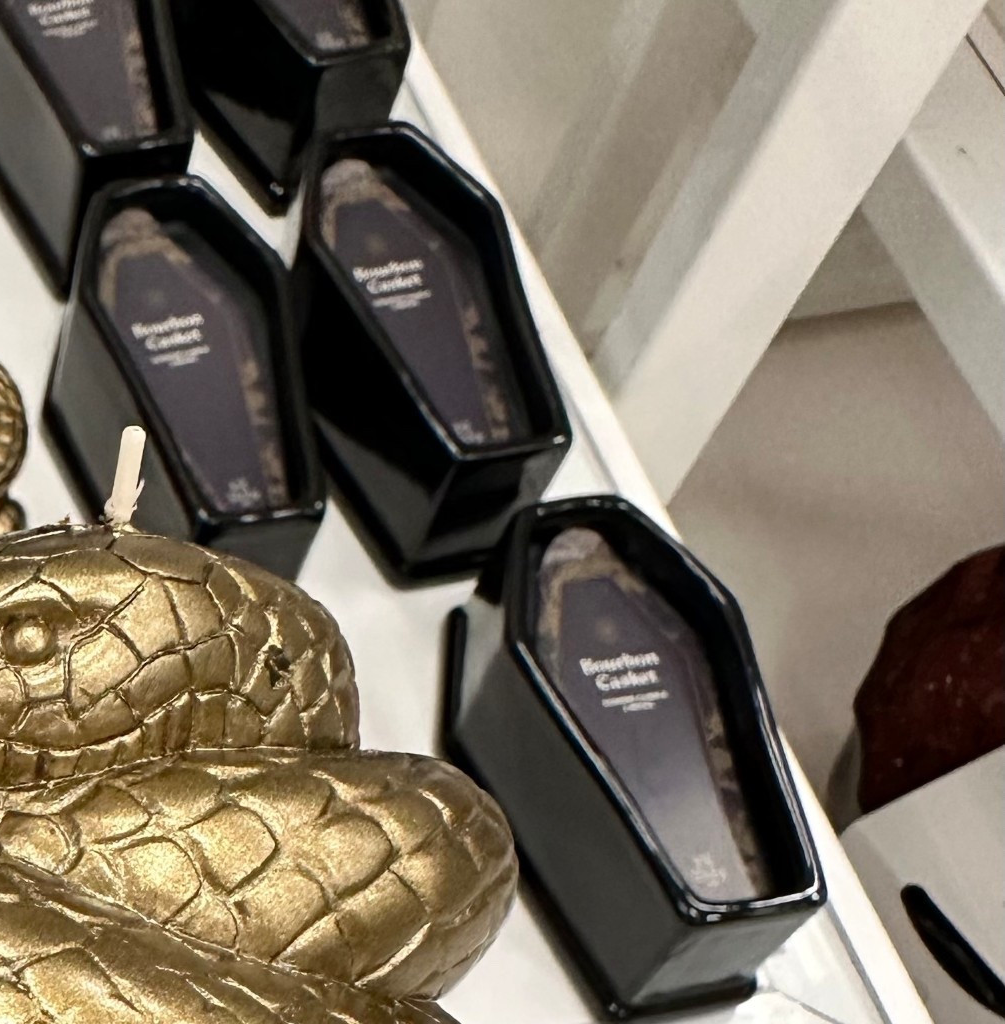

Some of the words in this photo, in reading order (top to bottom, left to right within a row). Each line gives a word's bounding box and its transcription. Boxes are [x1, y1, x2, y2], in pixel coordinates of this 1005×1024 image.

[366, 273, 423, 294] Casket
[131, 313, 204, 338] Bourbon
[145, 328, 202, 351] Casket
[579, 652, 660, 676] Bourbon
[595, 669, 658, 691] Casket
